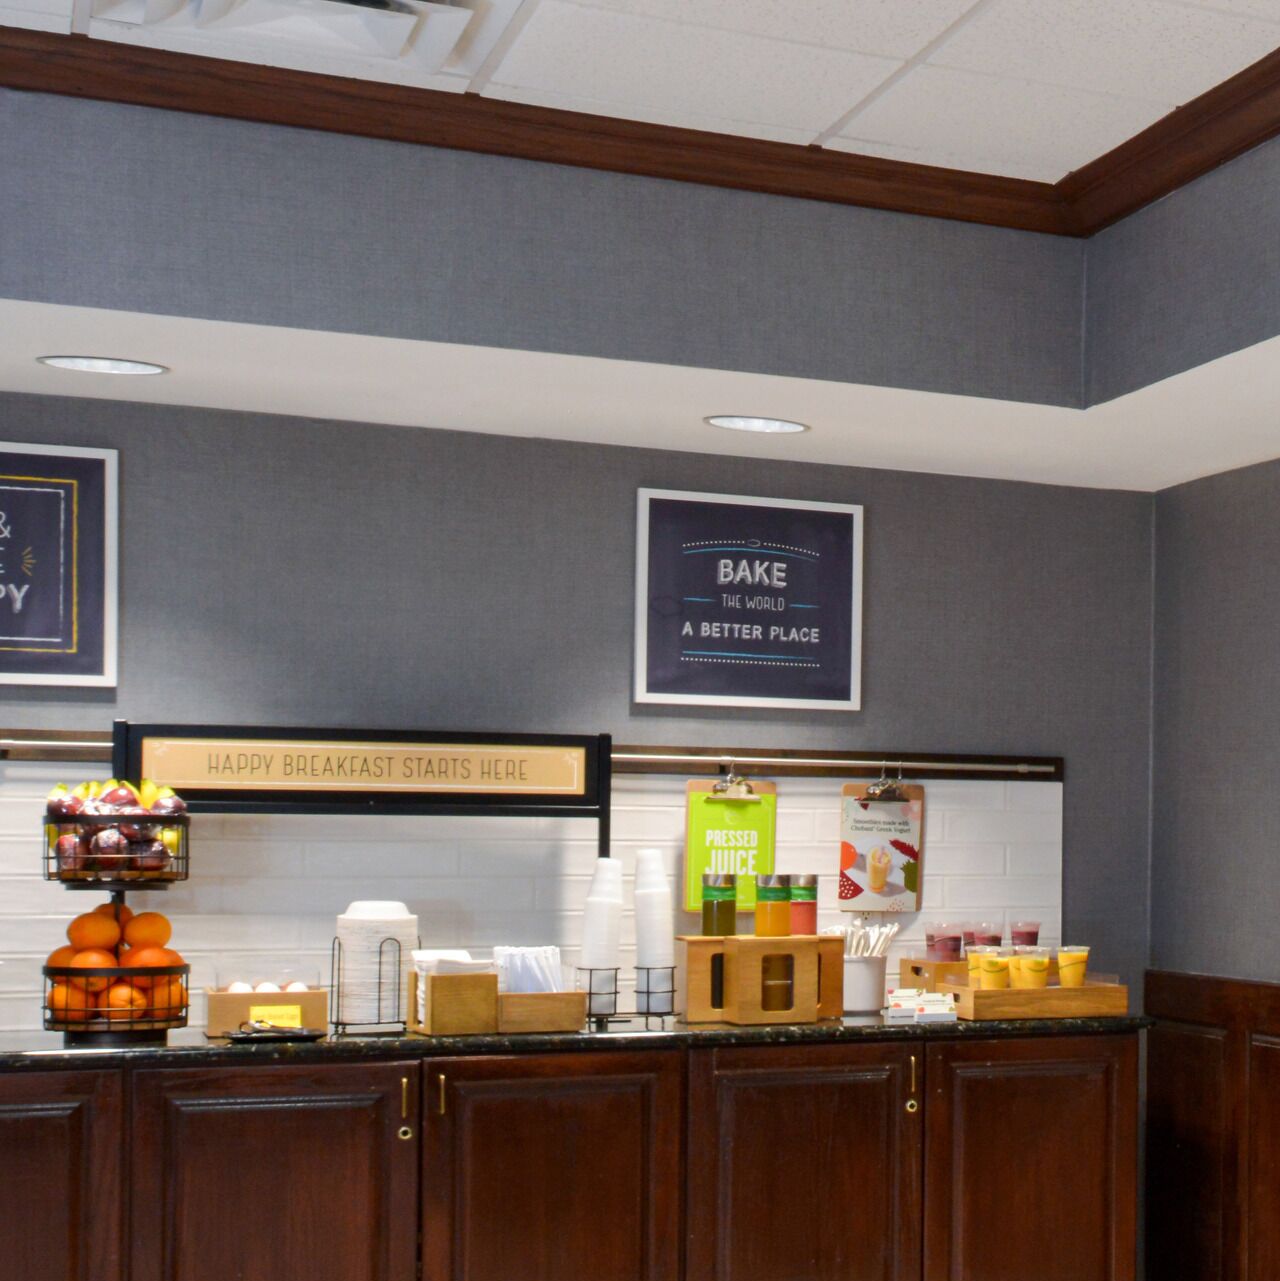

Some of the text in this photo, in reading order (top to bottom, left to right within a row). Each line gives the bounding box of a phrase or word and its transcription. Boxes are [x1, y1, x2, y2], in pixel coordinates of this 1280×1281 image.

[717, 559, 788, 589] BAKE
[722, 593, 786, 612] THE WORLD
[681, 621, 820, 643] A BETTER PLACE
[207, 752, 528, 781] HAPPY BREAKFAST STARTS HERE
[705, 829, 758, 848] PRESSED
[704, 849, 758, 876] JUICE
